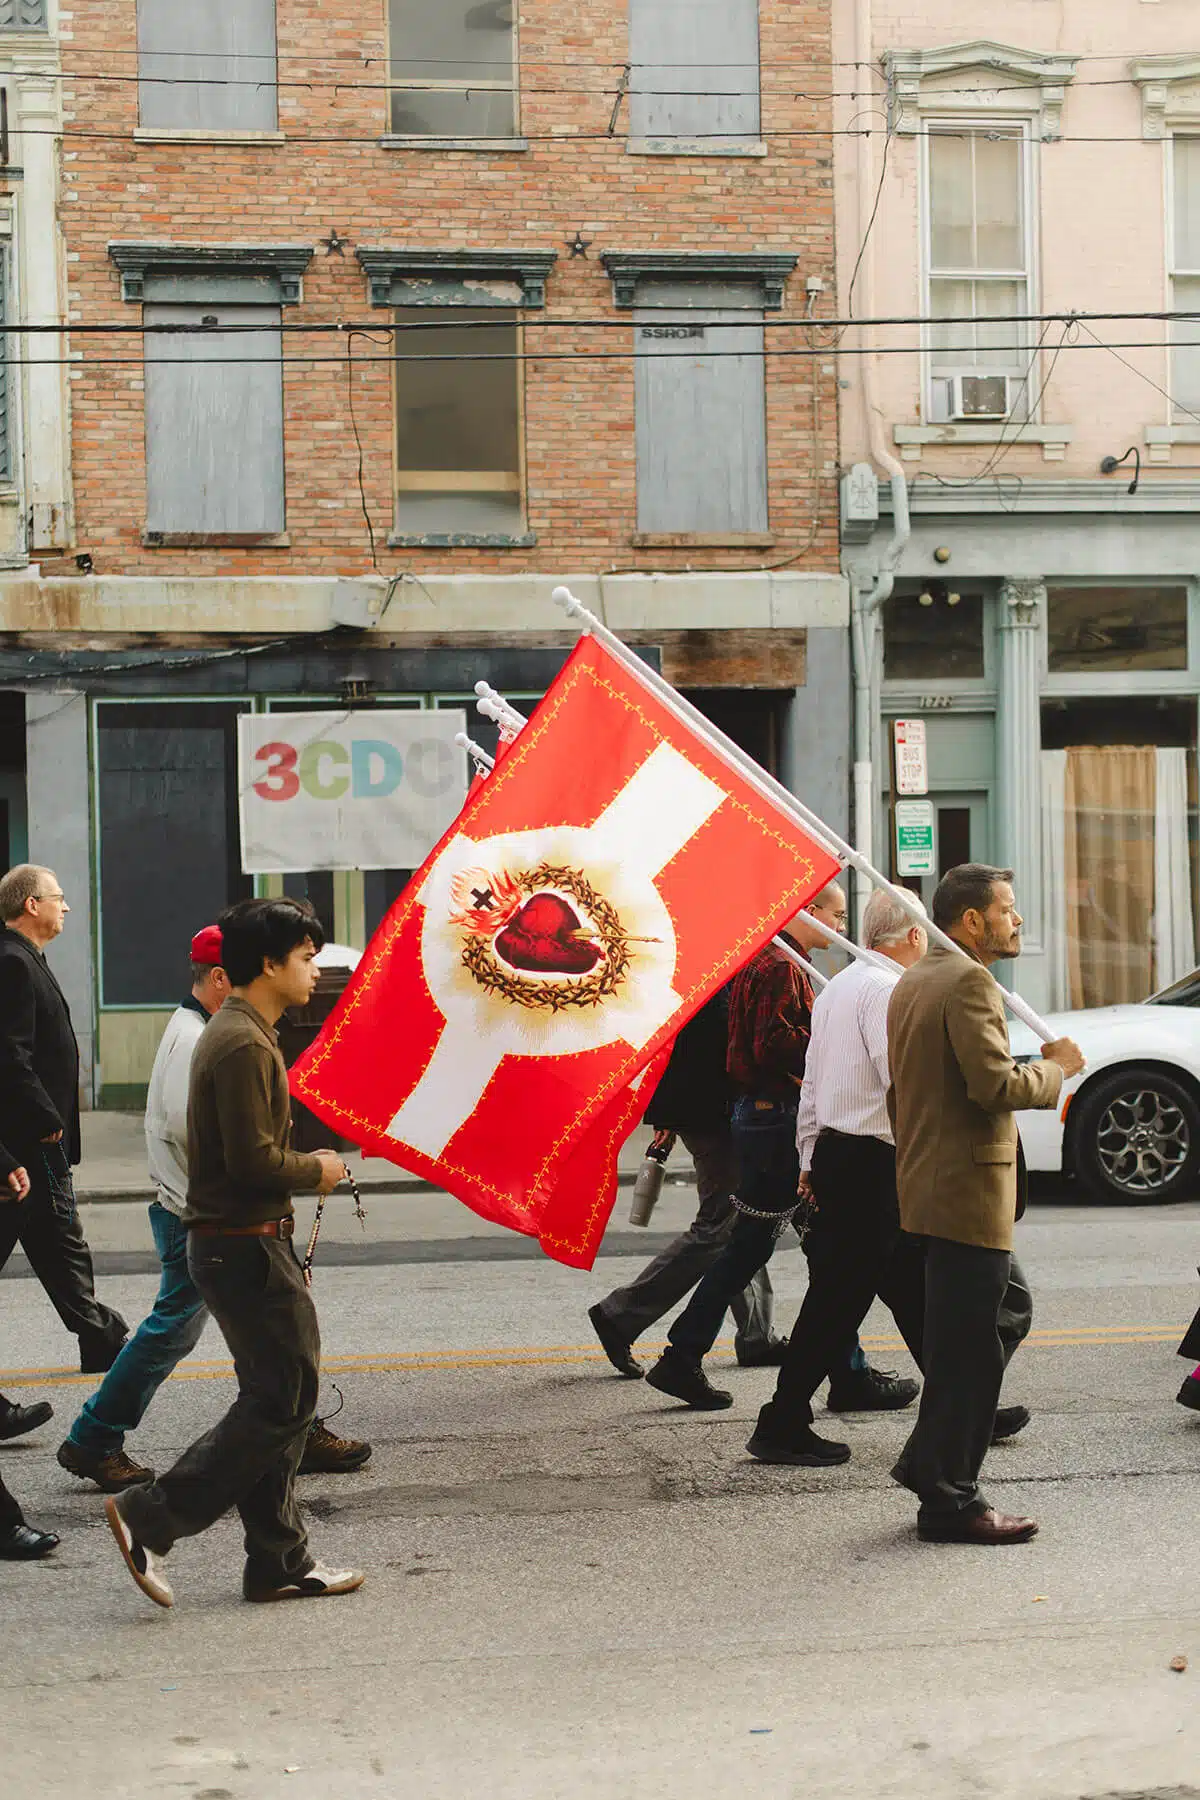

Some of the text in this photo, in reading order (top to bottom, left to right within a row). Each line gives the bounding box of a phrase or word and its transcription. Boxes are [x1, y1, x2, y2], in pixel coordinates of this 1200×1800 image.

[903, 747, 920, 761] BUS
[252, 738, 454, 802] 3CDC
[902, 764, 922, 778] STOP
